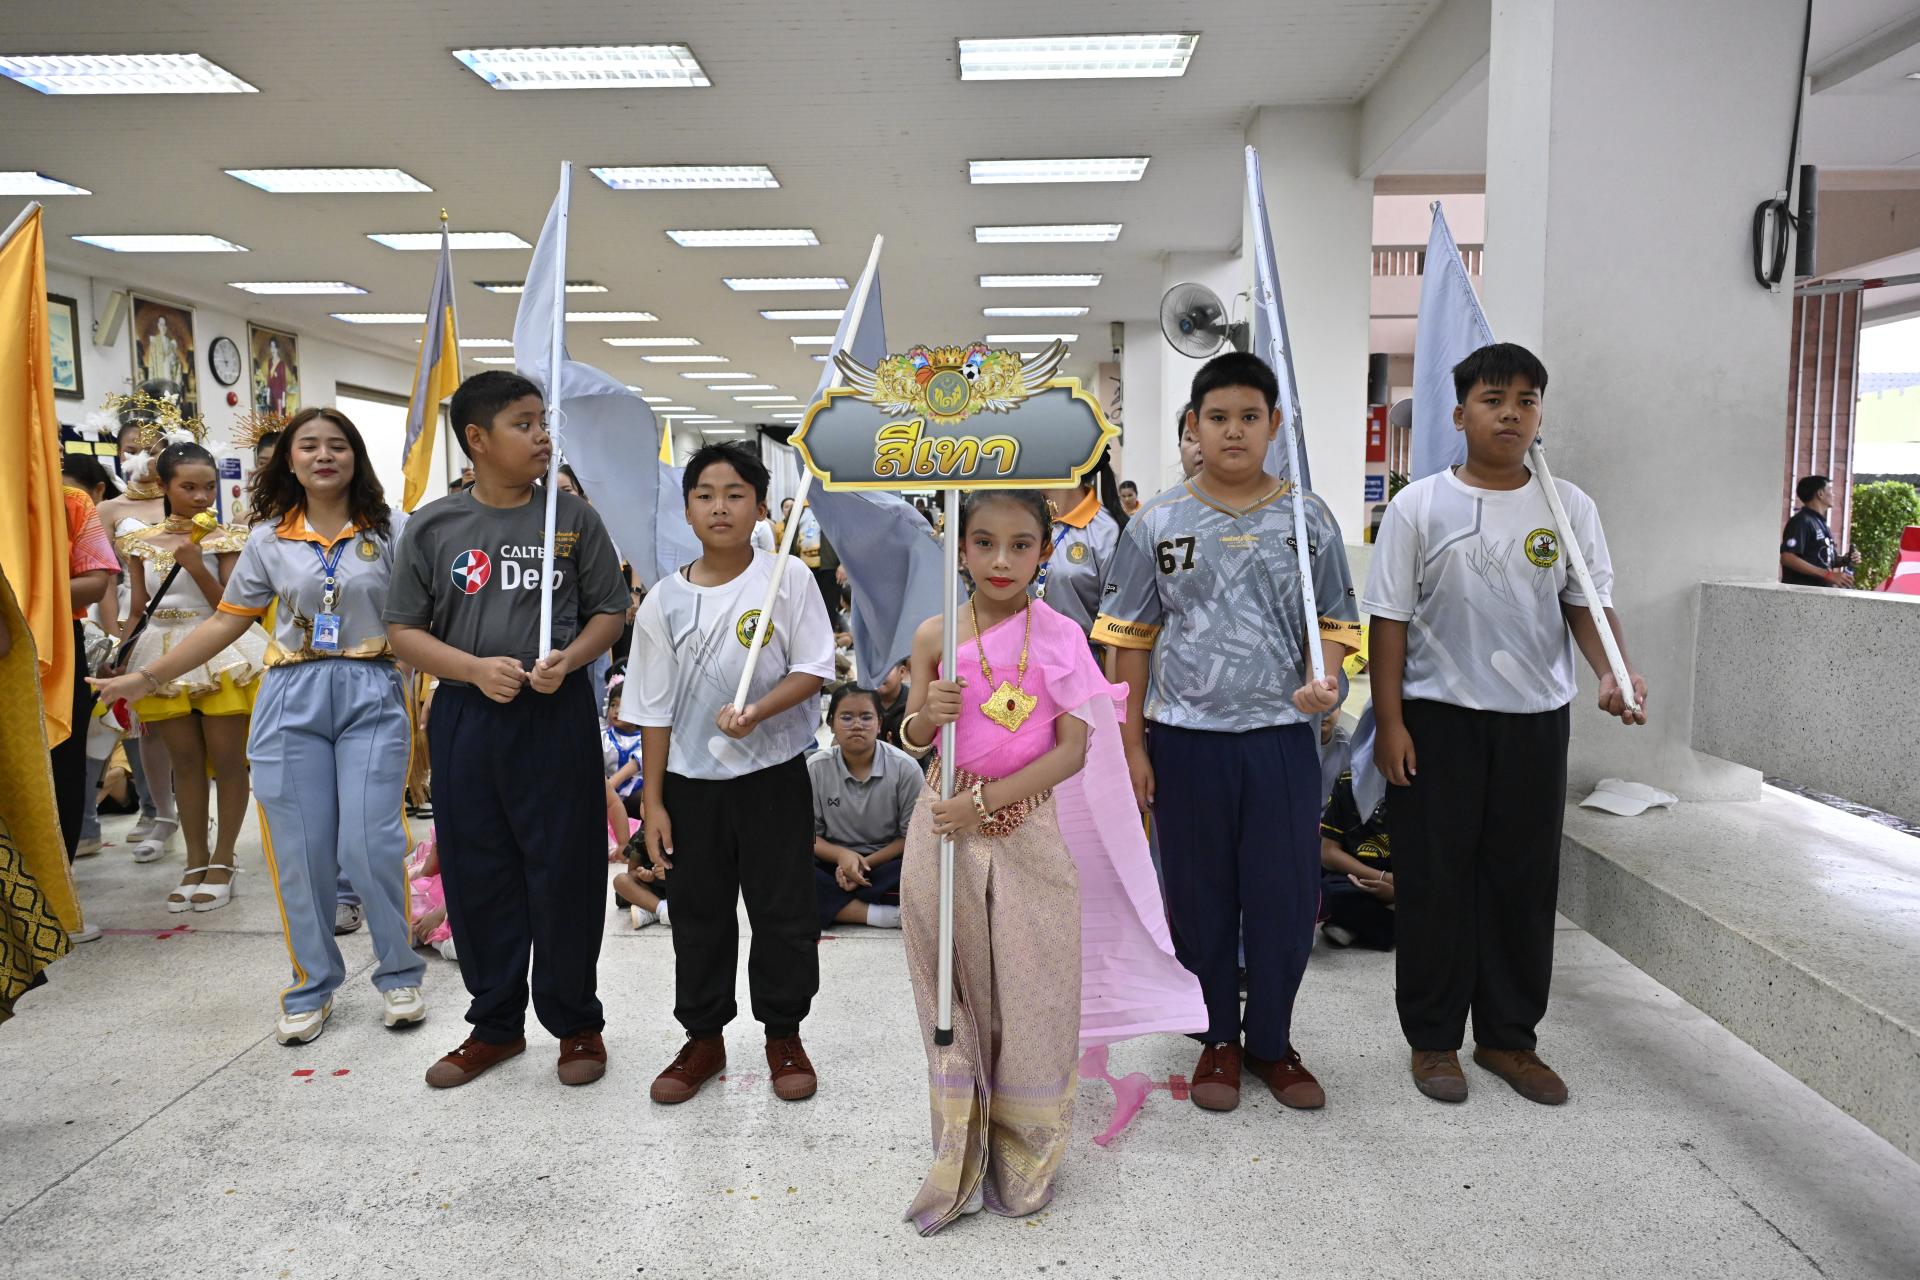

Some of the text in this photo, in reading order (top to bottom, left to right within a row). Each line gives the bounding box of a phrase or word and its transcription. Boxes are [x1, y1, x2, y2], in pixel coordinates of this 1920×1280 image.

[874, 419, 1018, 475] สีเทา
[501, 545, 556, 559] CALTE
[1157, 537, 1195, 574] 67
[501, 561, 564, 590] Deo
